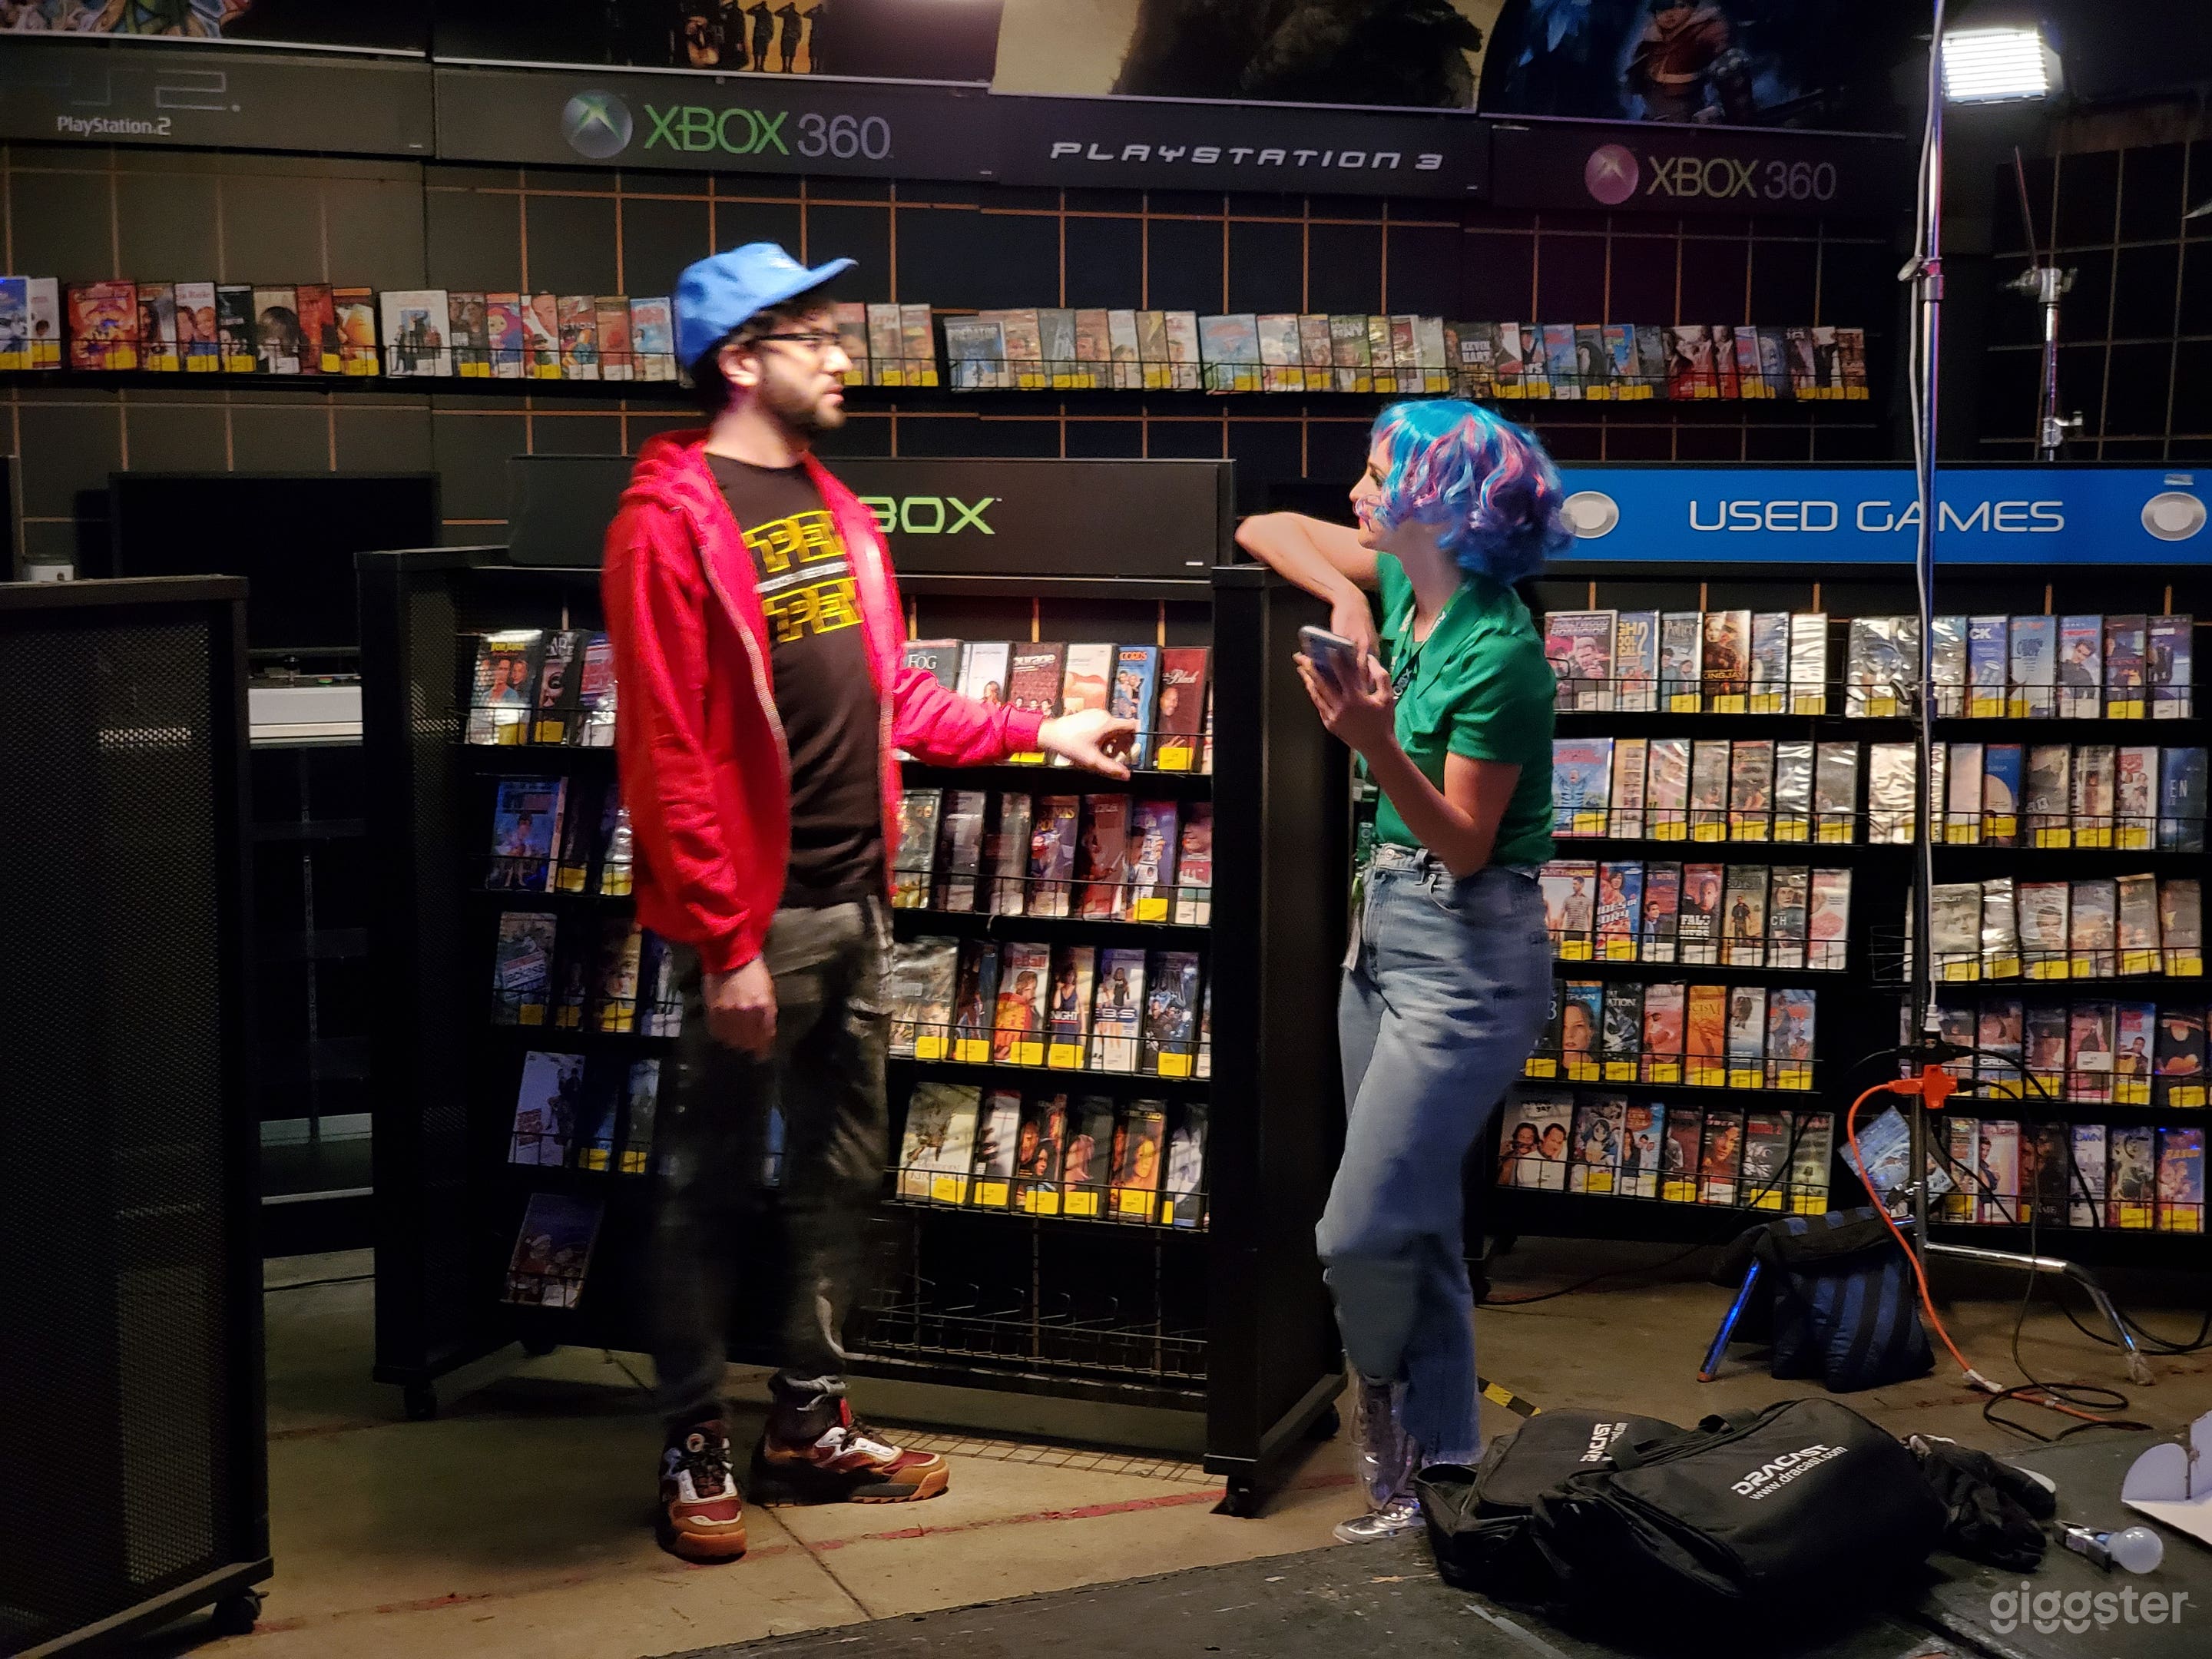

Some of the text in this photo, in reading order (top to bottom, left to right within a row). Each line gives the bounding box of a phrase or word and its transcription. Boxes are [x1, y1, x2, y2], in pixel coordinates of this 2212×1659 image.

[644, 104, 891, 160] XBOX 360
[1049, 143, 1444, 171] PLAYSTATION 3
[1647, 156, 1837, 200] XBOX 360
[858, 496, 996, 535] BOX
[1690, 501, 2065, 531] USED GAMES
[1730, 1444, 1830, 1495] DRACAST
[1749, 1445, 1849, 1501] www.dracast.com
